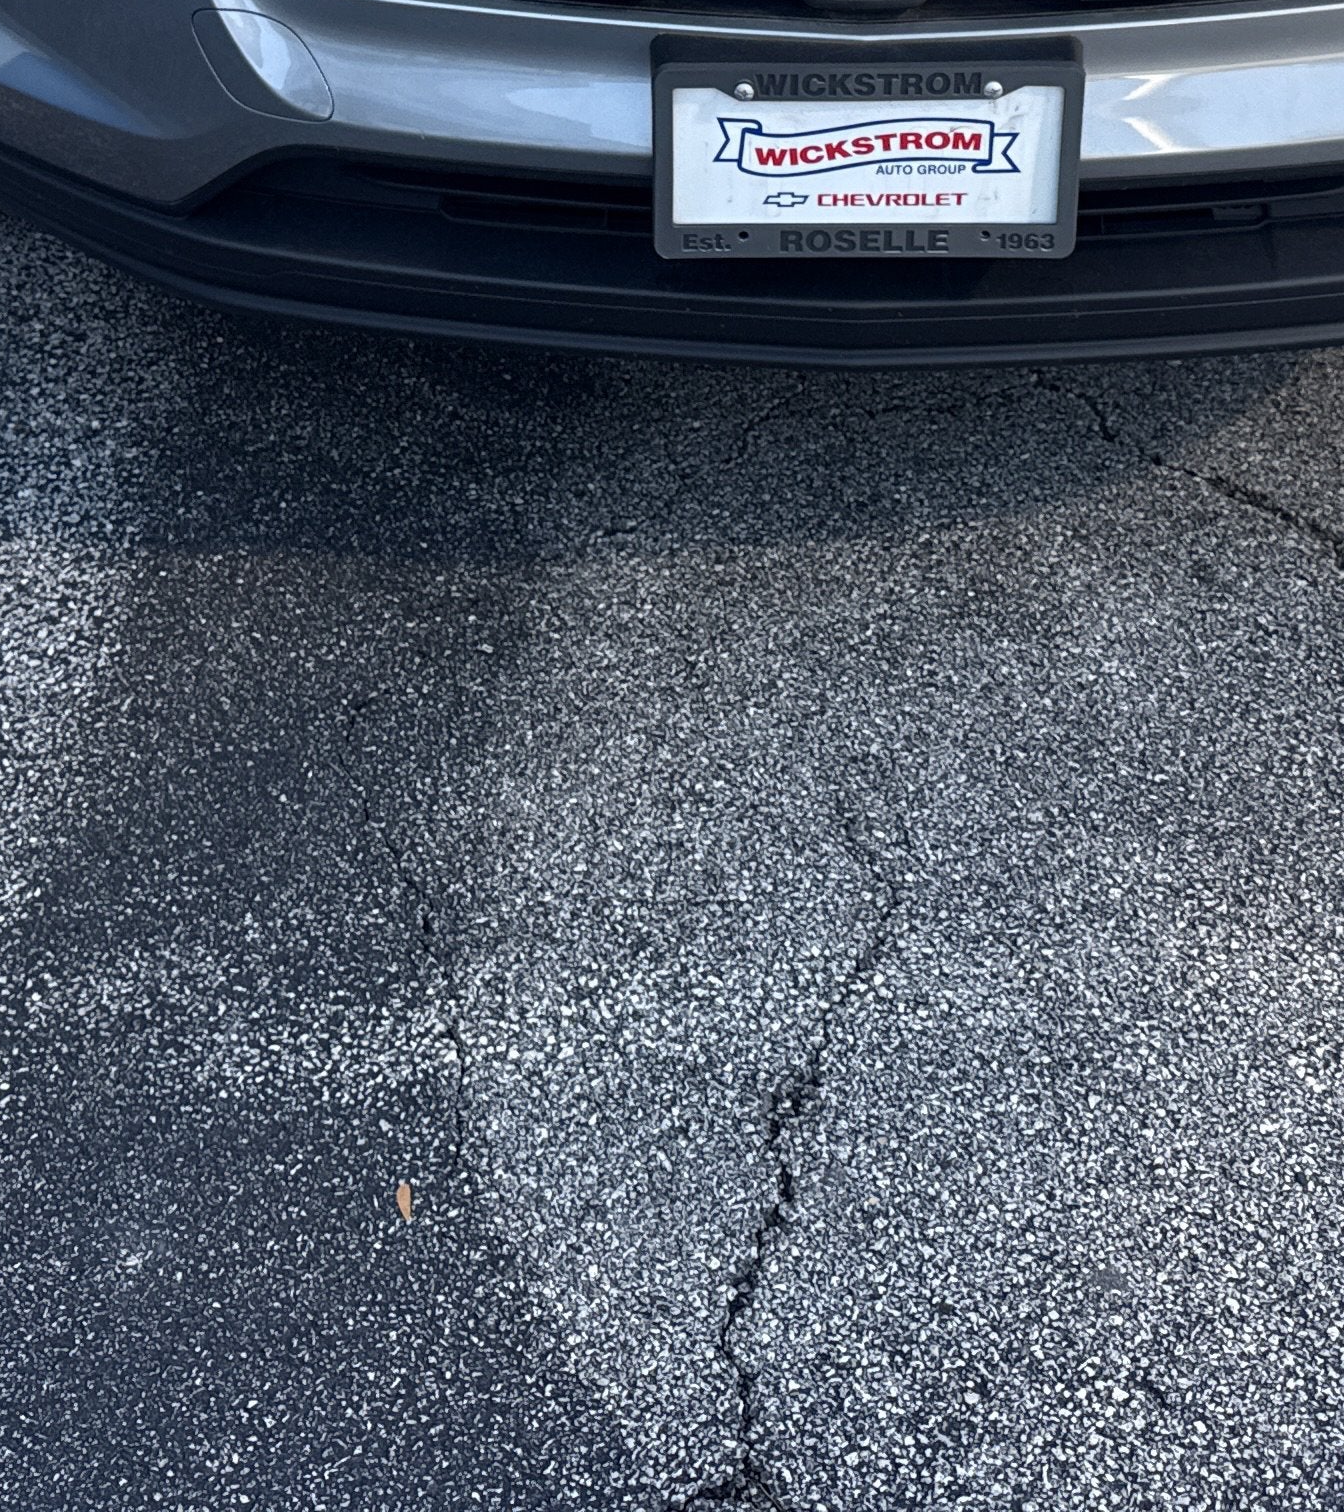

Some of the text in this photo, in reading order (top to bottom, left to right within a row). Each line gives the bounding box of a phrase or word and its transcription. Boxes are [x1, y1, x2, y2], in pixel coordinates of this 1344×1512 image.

[757, 72, 983, 97] WICKSTROM
[754, 131, 983, 167] WICKSTROM
[875, 164, 967, 175] AUTO GROUP
[816, 192, 969, 207] CHEVROLET
[682, 229, 1056, 252] Est. ROSELLE 1963
